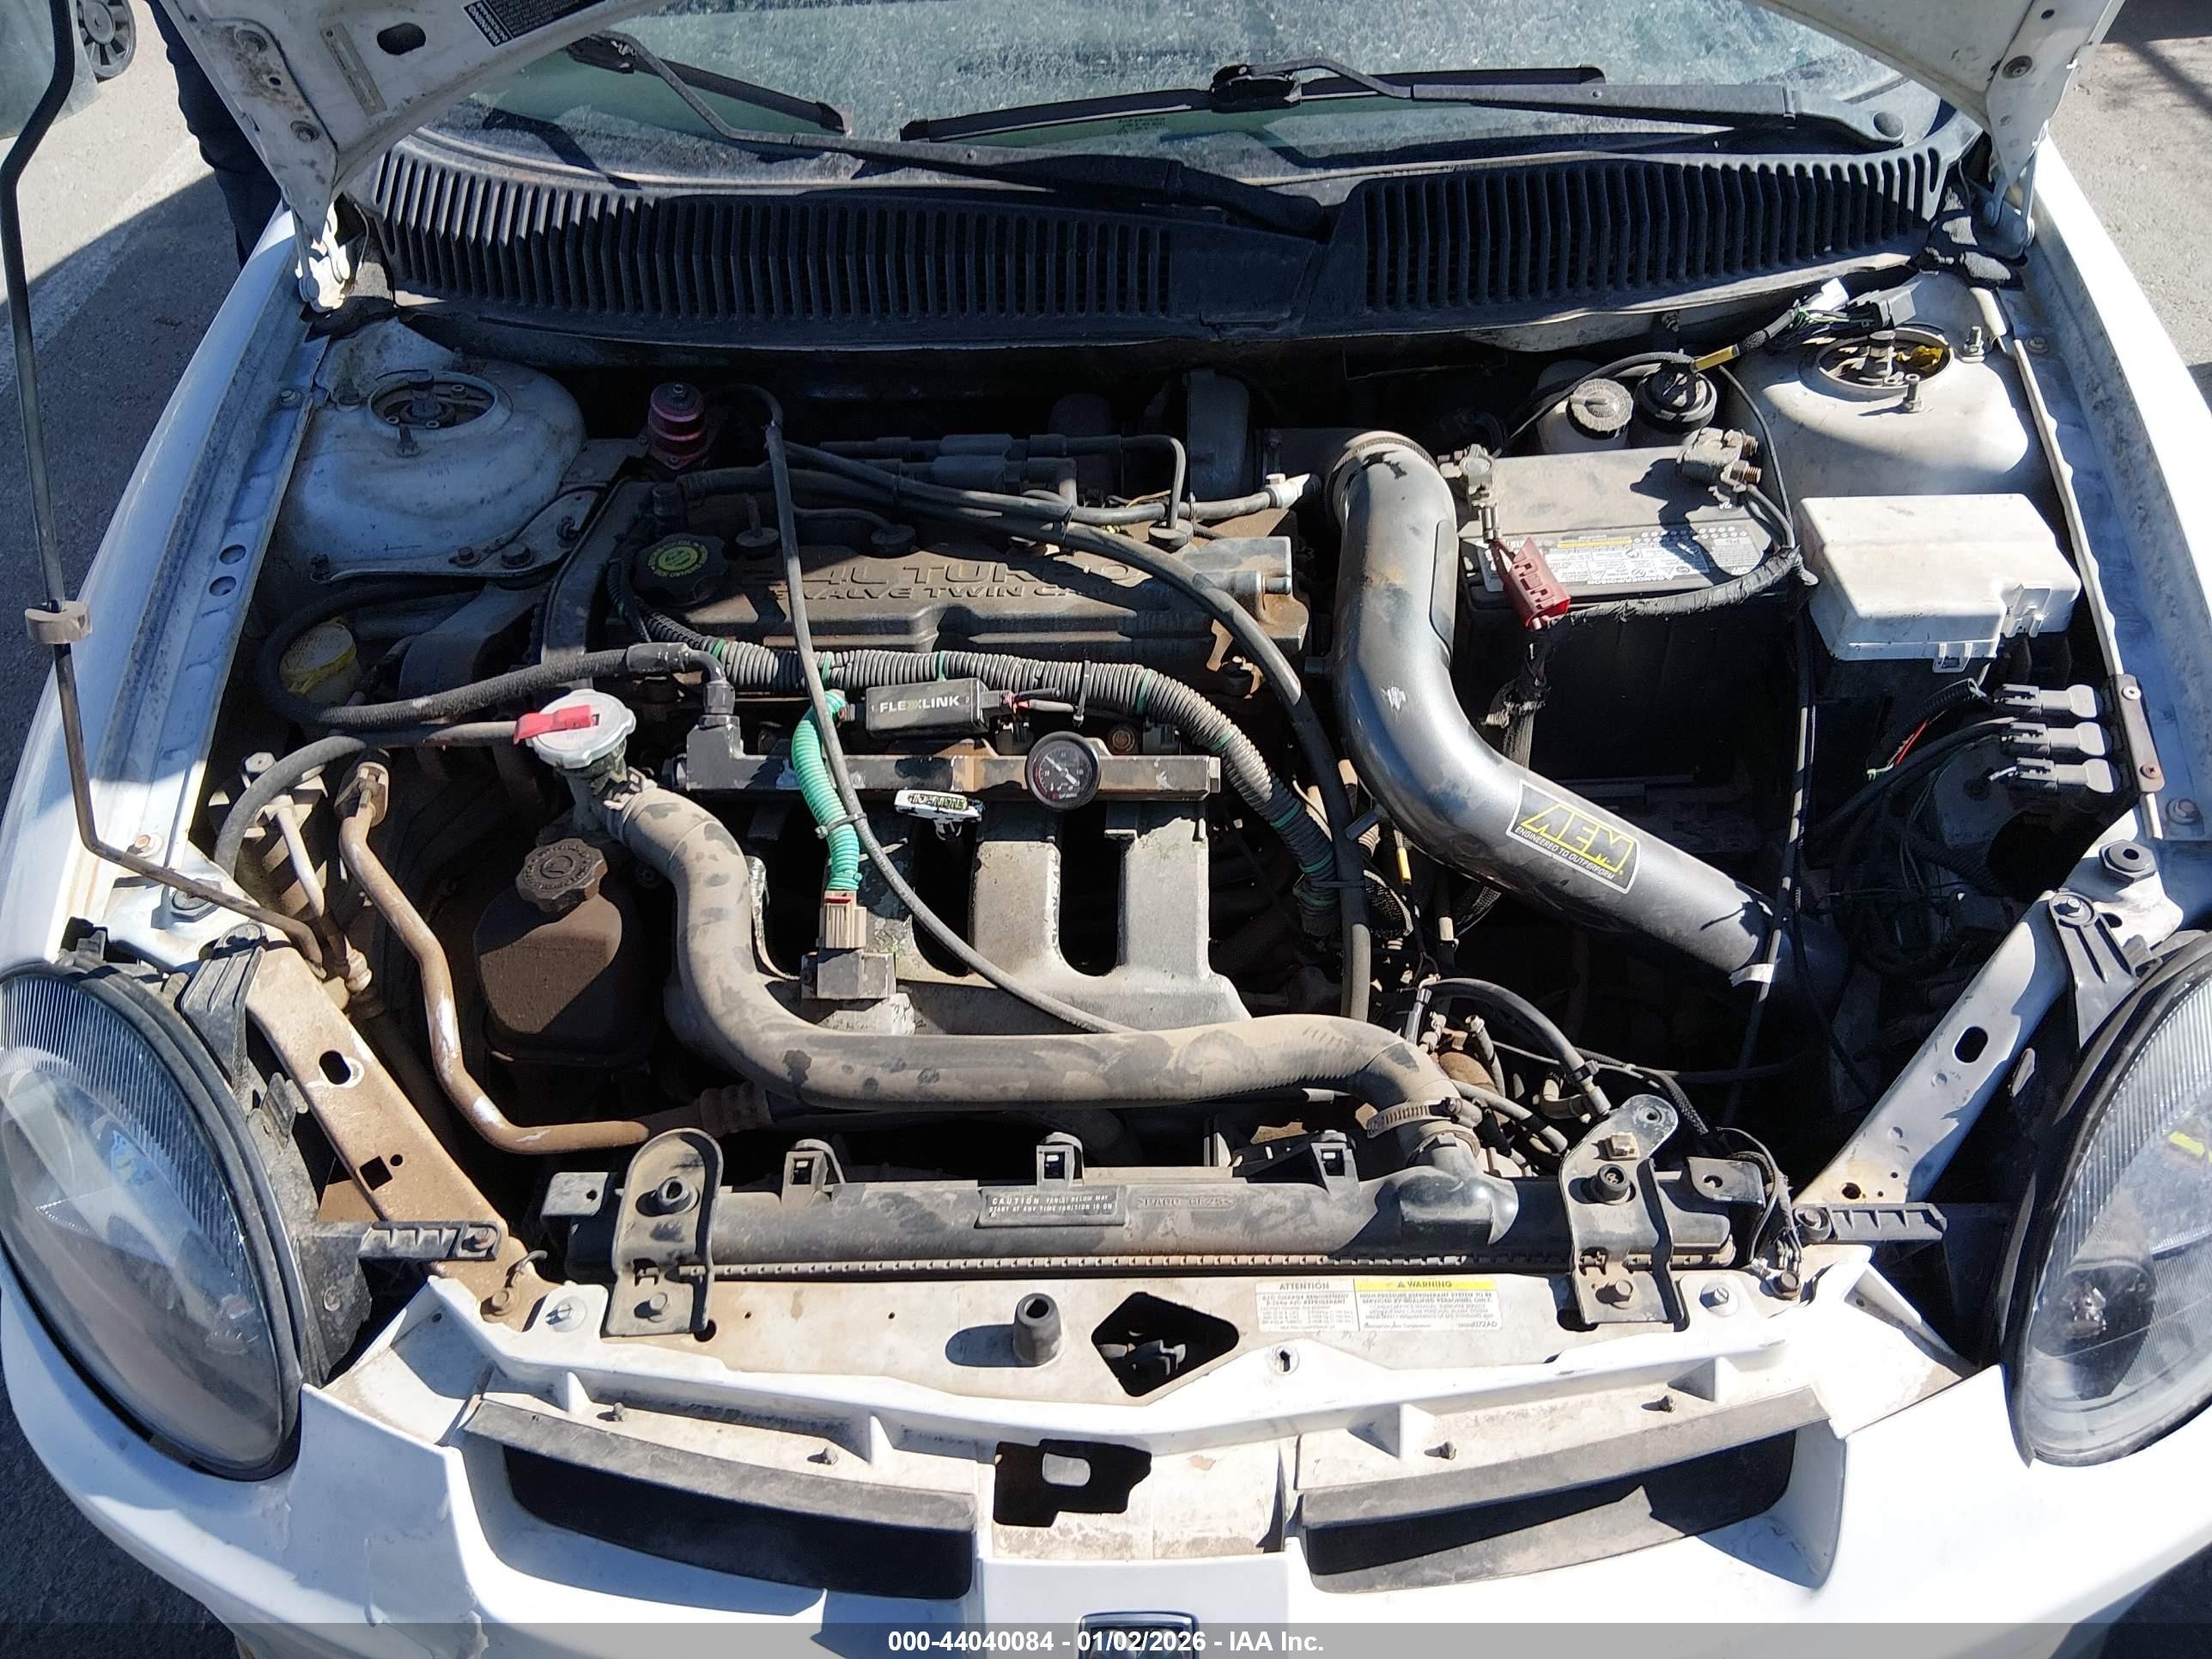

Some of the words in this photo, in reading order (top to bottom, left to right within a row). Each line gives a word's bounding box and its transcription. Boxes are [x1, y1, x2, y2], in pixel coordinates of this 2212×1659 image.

[923, 586, 1024, 599] TWIN
[1519, 803, 1635, 873] AEM
[1514, 826, 1560, 853] ENGINEERED
[1559, 847, 1570, 858] TO
[1568, 852, 1615, 880] OUTPERFORM
[992, 1196, 1039, 1205] CAUTION
[1279, 1281, 1330, 1291] ATTENTION
